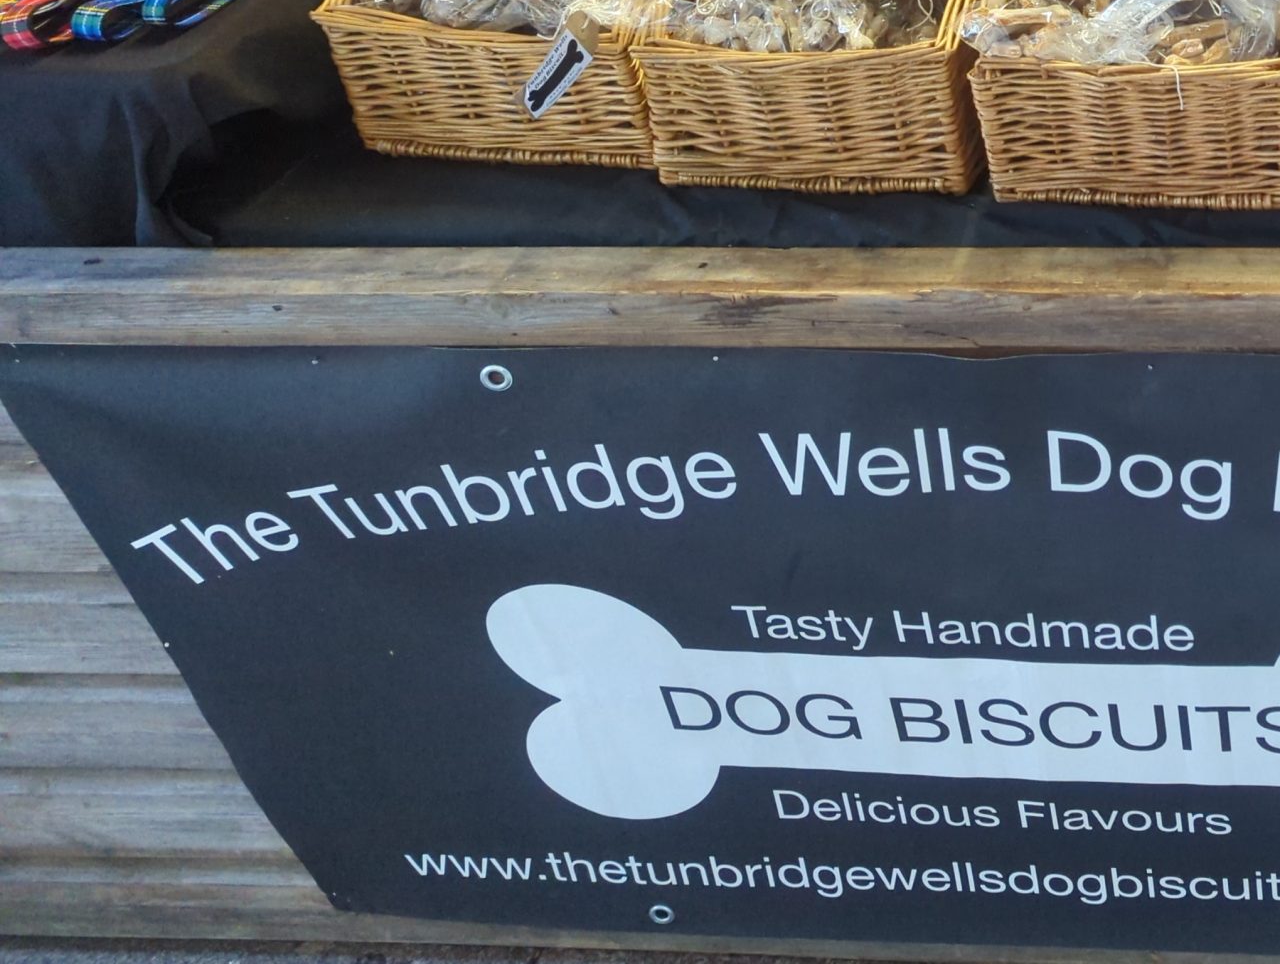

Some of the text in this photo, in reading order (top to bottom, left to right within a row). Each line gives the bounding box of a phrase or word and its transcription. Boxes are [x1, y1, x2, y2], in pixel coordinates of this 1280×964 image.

[130, 516, 299, 585] The
[287, 443, 738, 540] Tunbridge
[758, 427, 1012, 497] Wells
[1047, 430, 1232, 521] Dog
[731, 605, 1195, 653] Tasty Handmade
[658, 686, 863, 740] DOG
[772, 789, 1233, 835] Delicious Flavours
